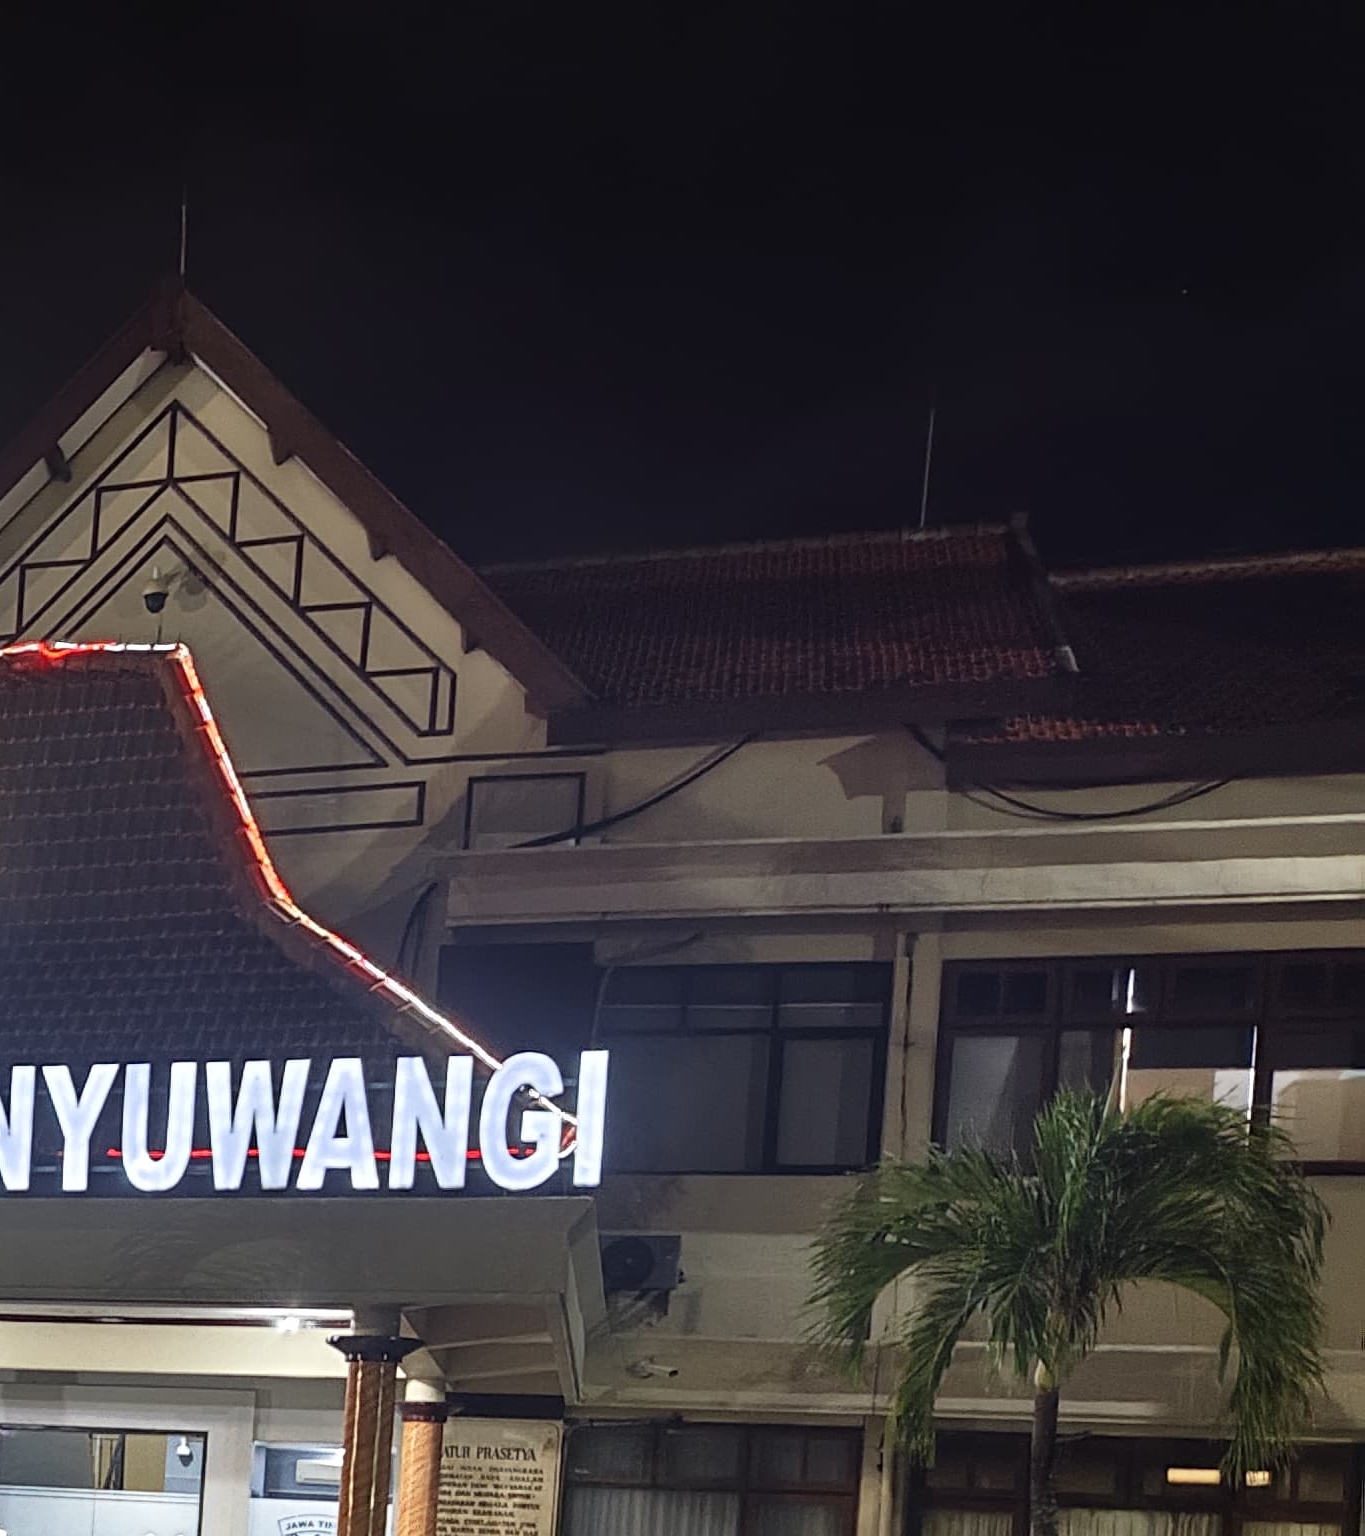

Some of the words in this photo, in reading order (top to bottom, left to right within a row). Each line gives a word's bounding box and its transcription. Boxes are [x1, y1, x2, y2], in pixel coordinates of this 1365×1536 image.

[442, 1445, 470, 1460] ATUR
[476, 1446, 537, 1462] PRASETYA
[285, 1519, 315, 1531] JAWA
